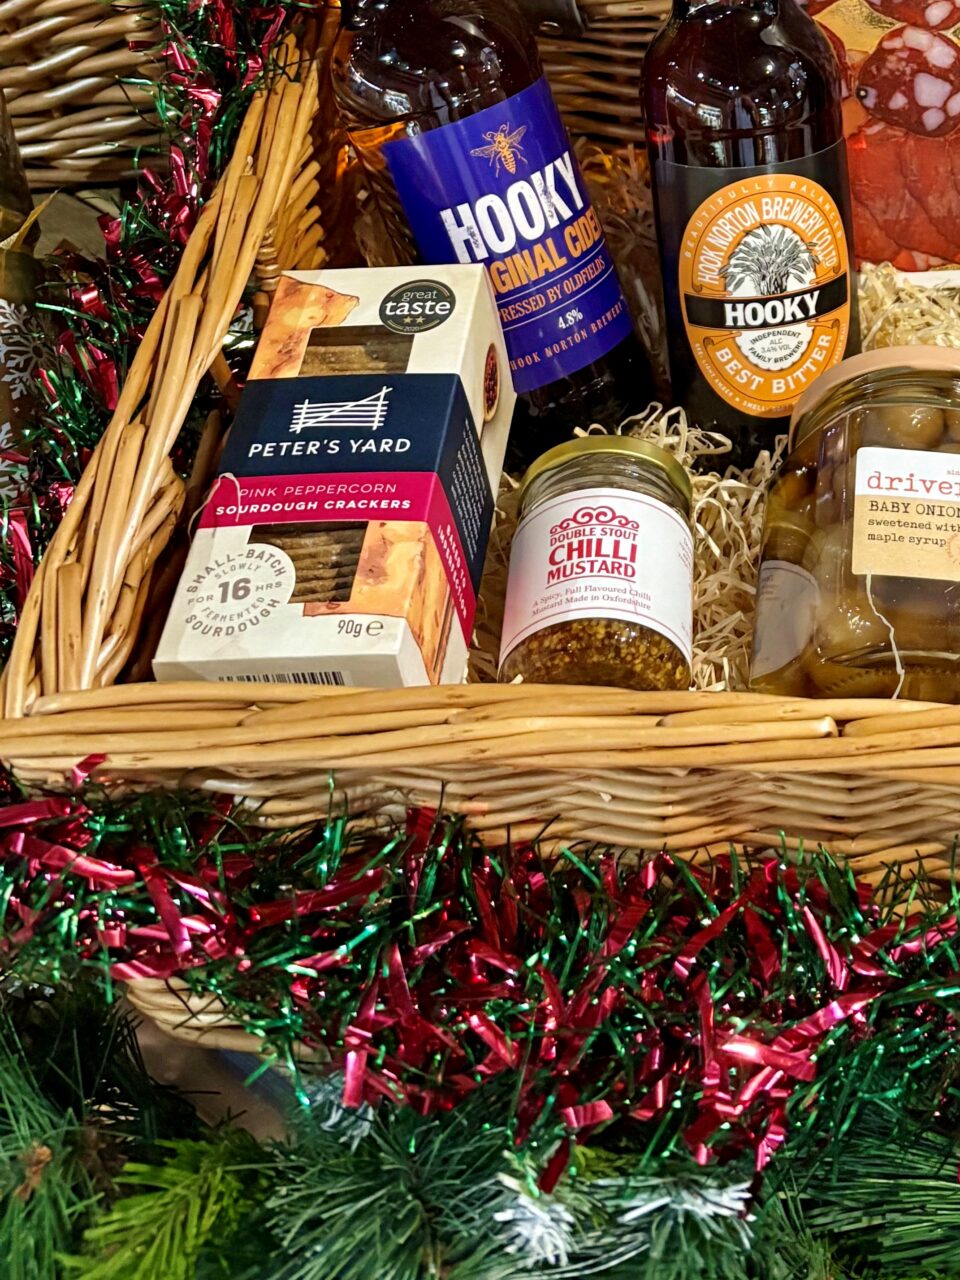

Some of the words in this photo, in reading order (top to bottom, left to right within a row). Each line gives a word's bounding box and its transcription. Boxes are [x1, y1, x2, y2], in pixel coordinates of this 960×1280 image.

[440, 151, 585, 264] HOOKY
[761, 197, 824, 236] BREWERY
[706, 200, 761, 251] NORTON
[697, 244, 724, 284] HOOK
[401, 290, 438, 302] great
[498, 293, 546, 323] RESSED
[546, 284, 563, 304] BY
[563, 254, 606, 295] OLDFIELDS
[385, 300, 451, 315] taste
[558, 307, 584, 329] 4.8%
[723, 290, 820, 327] HOOKY
[510, 352, 541, 370] HOOK
[545, 328, 588, 358] NORTON
[590, 302, 623, 334] BREWERY
[750, 329, 802, 344] INDEPENDENT
[769, 337, 783, 345] ALC
[748, 347, 772, 363] FAMILY
[774, 340, 804, 364] BREWERS
[715, 347, 764, 391] BEST
[771, 334, 833, 394] BITTER
[248, 439, 341, 458] PETER'S
[350, 437, 411, 454] YARD
[240, 487, 276, 499] PINK
[284, 483, 397, 496] PEPPERCORN
[215, 501, 318, 516] SOURDOUGH
[324, 498, 411, 512] CRACKERS
[868, 500, 911, 515] BABY
[867, 518, 932, 532] sweetened
[549, 527, 597, 547] DOUBLE
[599, 527, 639, 542] STOUT
[867, 532, 905, 546] maple
[908, 535, 947, 548] syrup
[548, 538, 638, 566] CHILLI
[214, 562, 262, 580] SLOWLY
[546, 560, 636, 585] MUSTARD
[187, 594, 214, 605] FOR
[218, 577, 252, 604] 16
[255, 581, 283, 592] HRS
[565, 586, 582, 596] Full
[584, 585, 627, 596] Flavoured
[629, 588, 652, 601] Chilli
[201, 596, 265, 622] FERMENTED
[531, 599, 563, 617] Mustard
[565, 596, 588, 606] Made
[602, 594, 652, 610] Oxfordshire
[185, 598, 281, 637] SOURDOUGH
